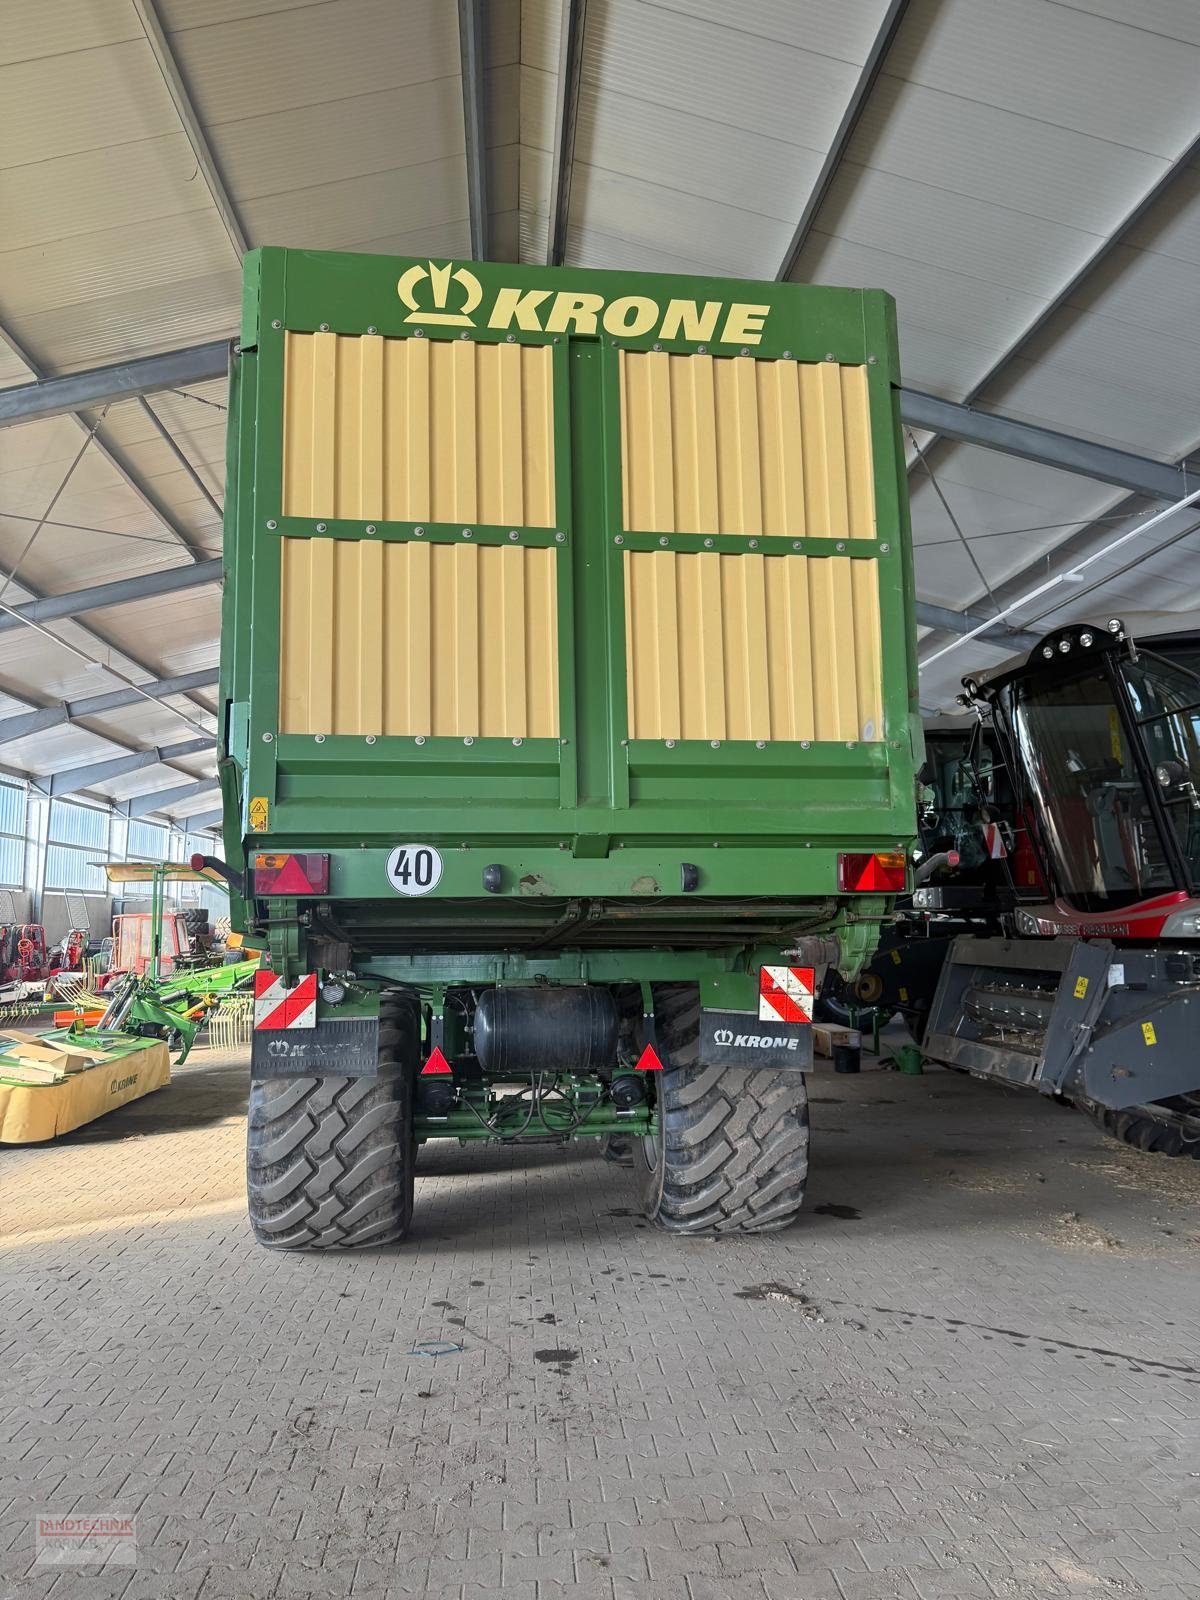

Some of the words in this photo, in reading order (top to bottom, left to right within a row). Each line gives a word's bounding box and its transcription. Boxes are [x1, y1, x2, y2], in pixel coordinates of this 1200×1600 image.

[487, 288, 771, 345] KRONE
[394, 849, 433, 886] 40
[734, 1035, 800, 1051] KRONE
